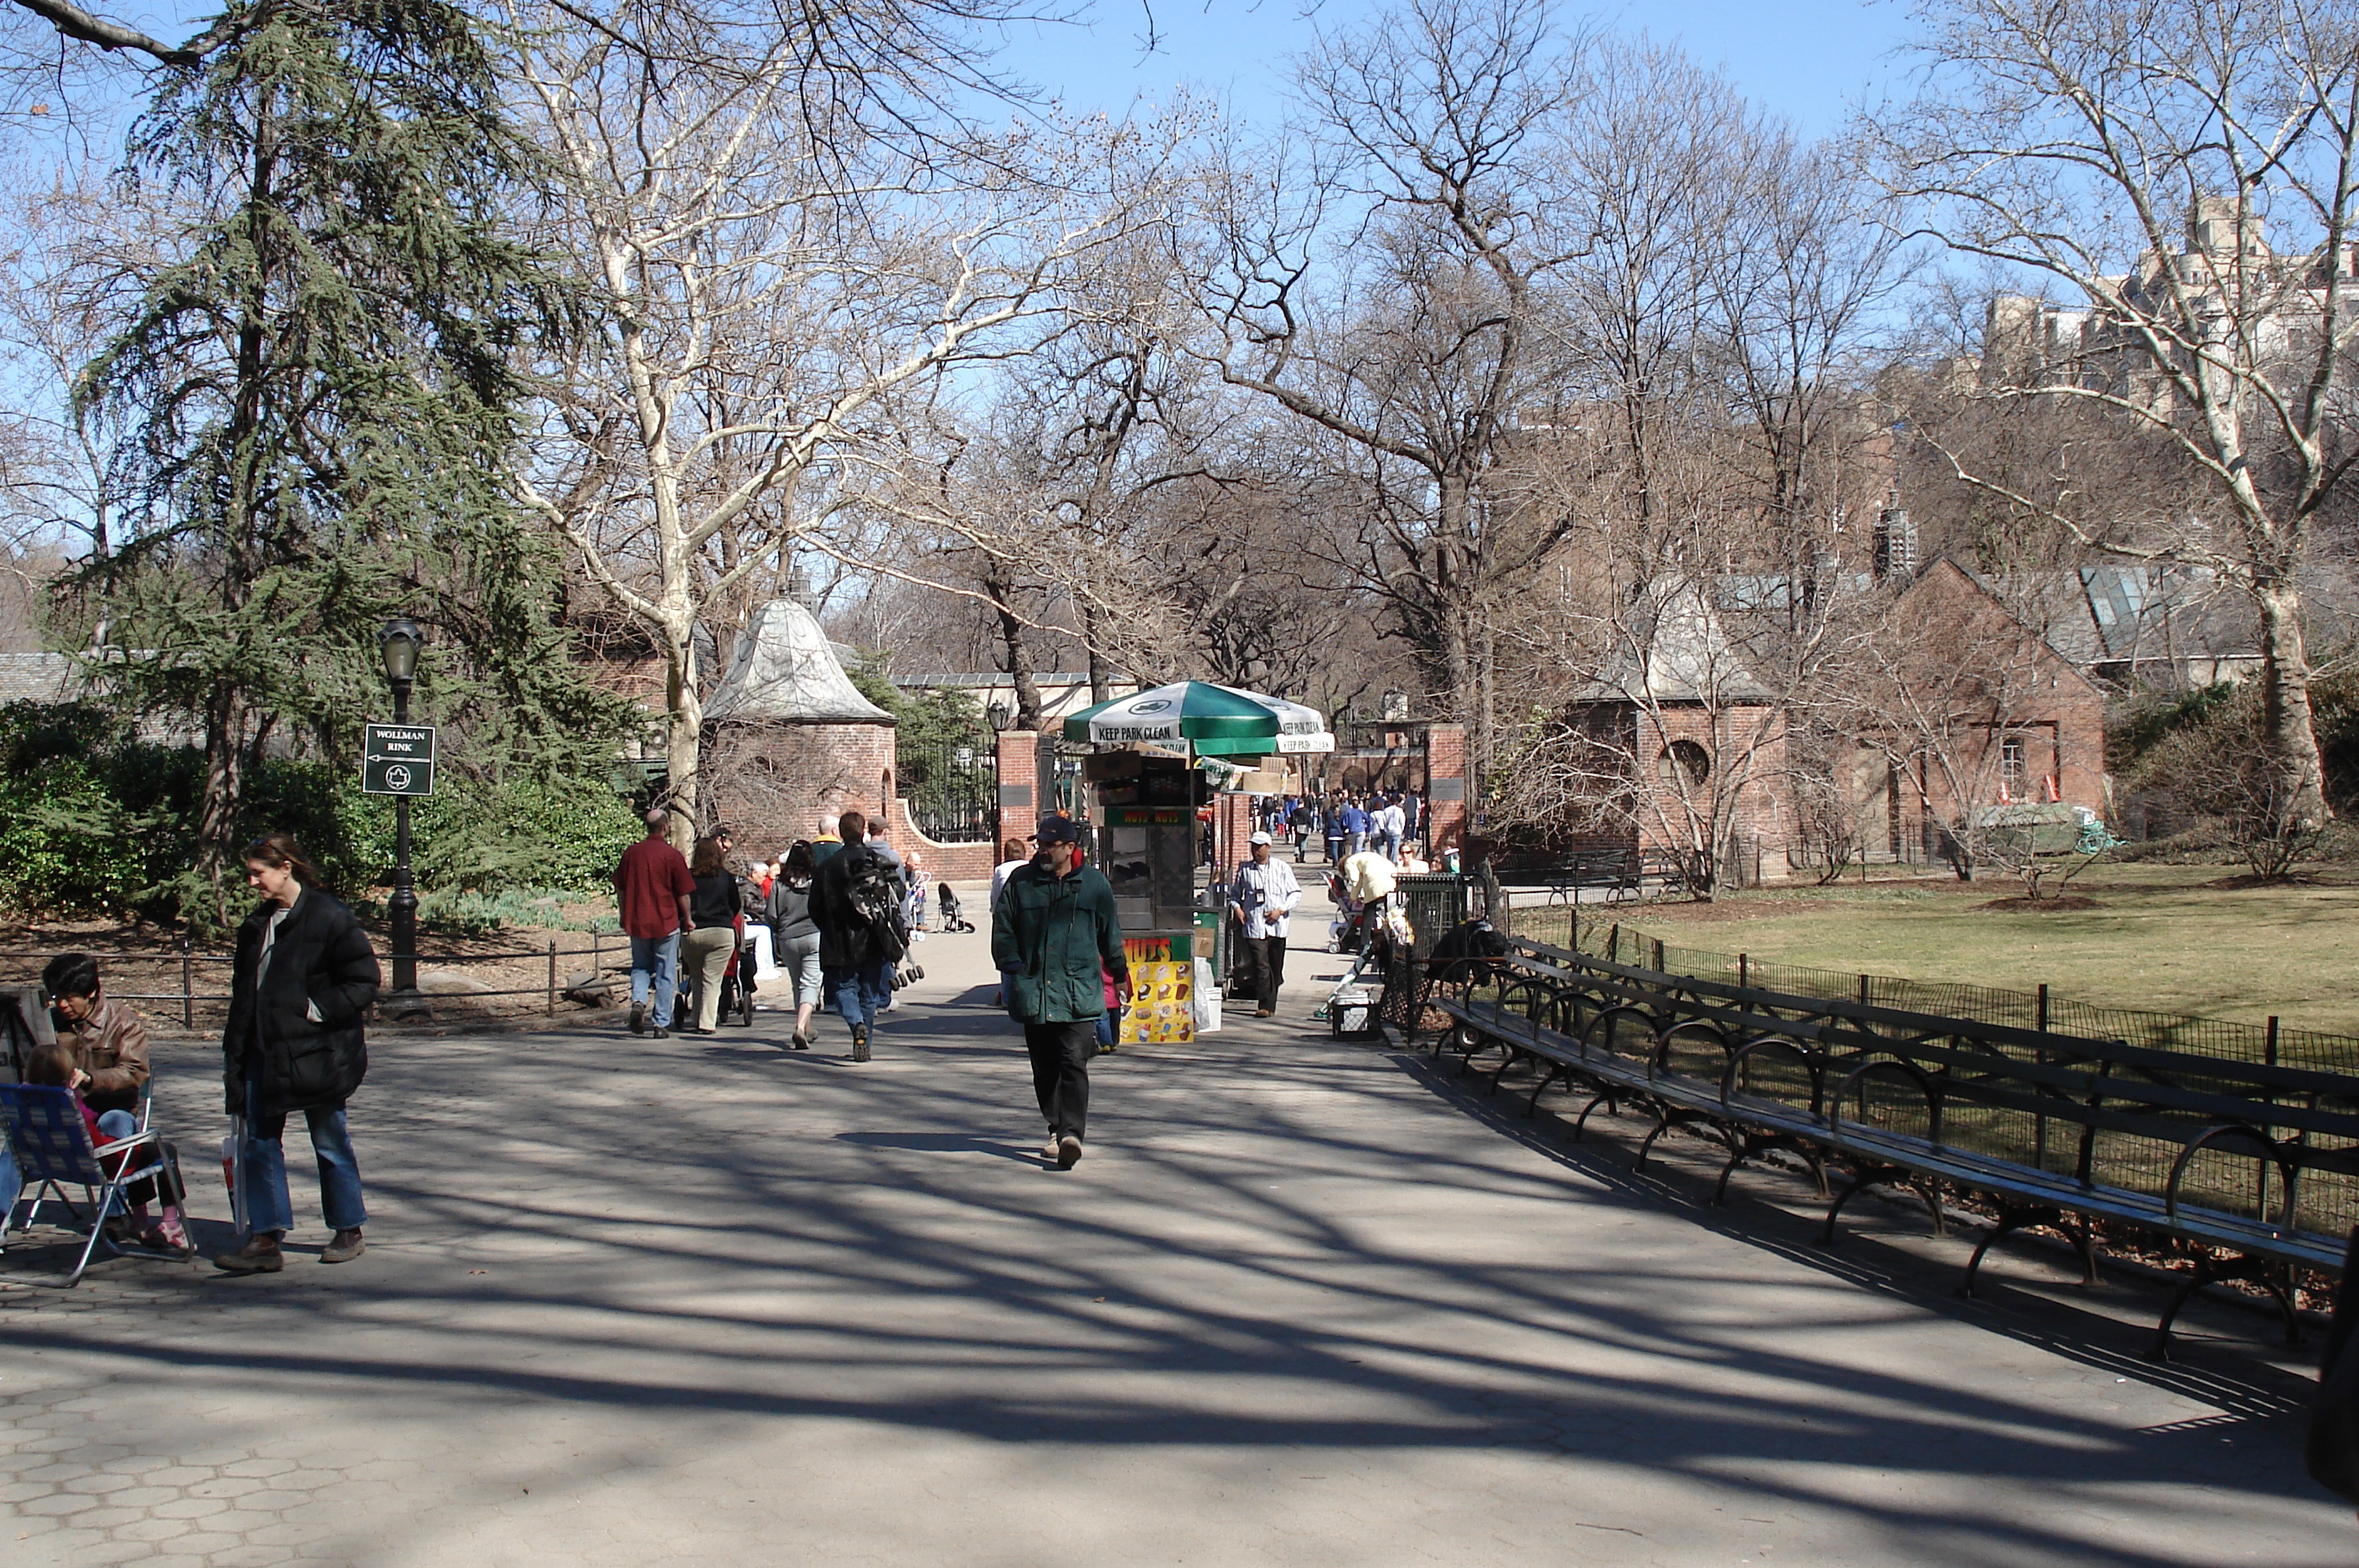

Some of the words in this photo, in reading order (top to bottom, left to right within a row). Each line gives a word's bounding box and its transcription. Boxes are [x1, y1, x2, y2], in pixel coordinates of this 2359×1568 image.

[376, 730, 426, 740] WOLLMAN
[1099, 727, 1119, 740] KEEP
[1122, 727, 1142, 740] PARK
[1144, 725, 1170, 740] CLEAN
[387, 742, 413, 752] RINK
[1283, 740, 1296, 750] KEEP
[1298, 740, 1311, 750] PARK
[1122, 937, 1171, 962] NUTS
